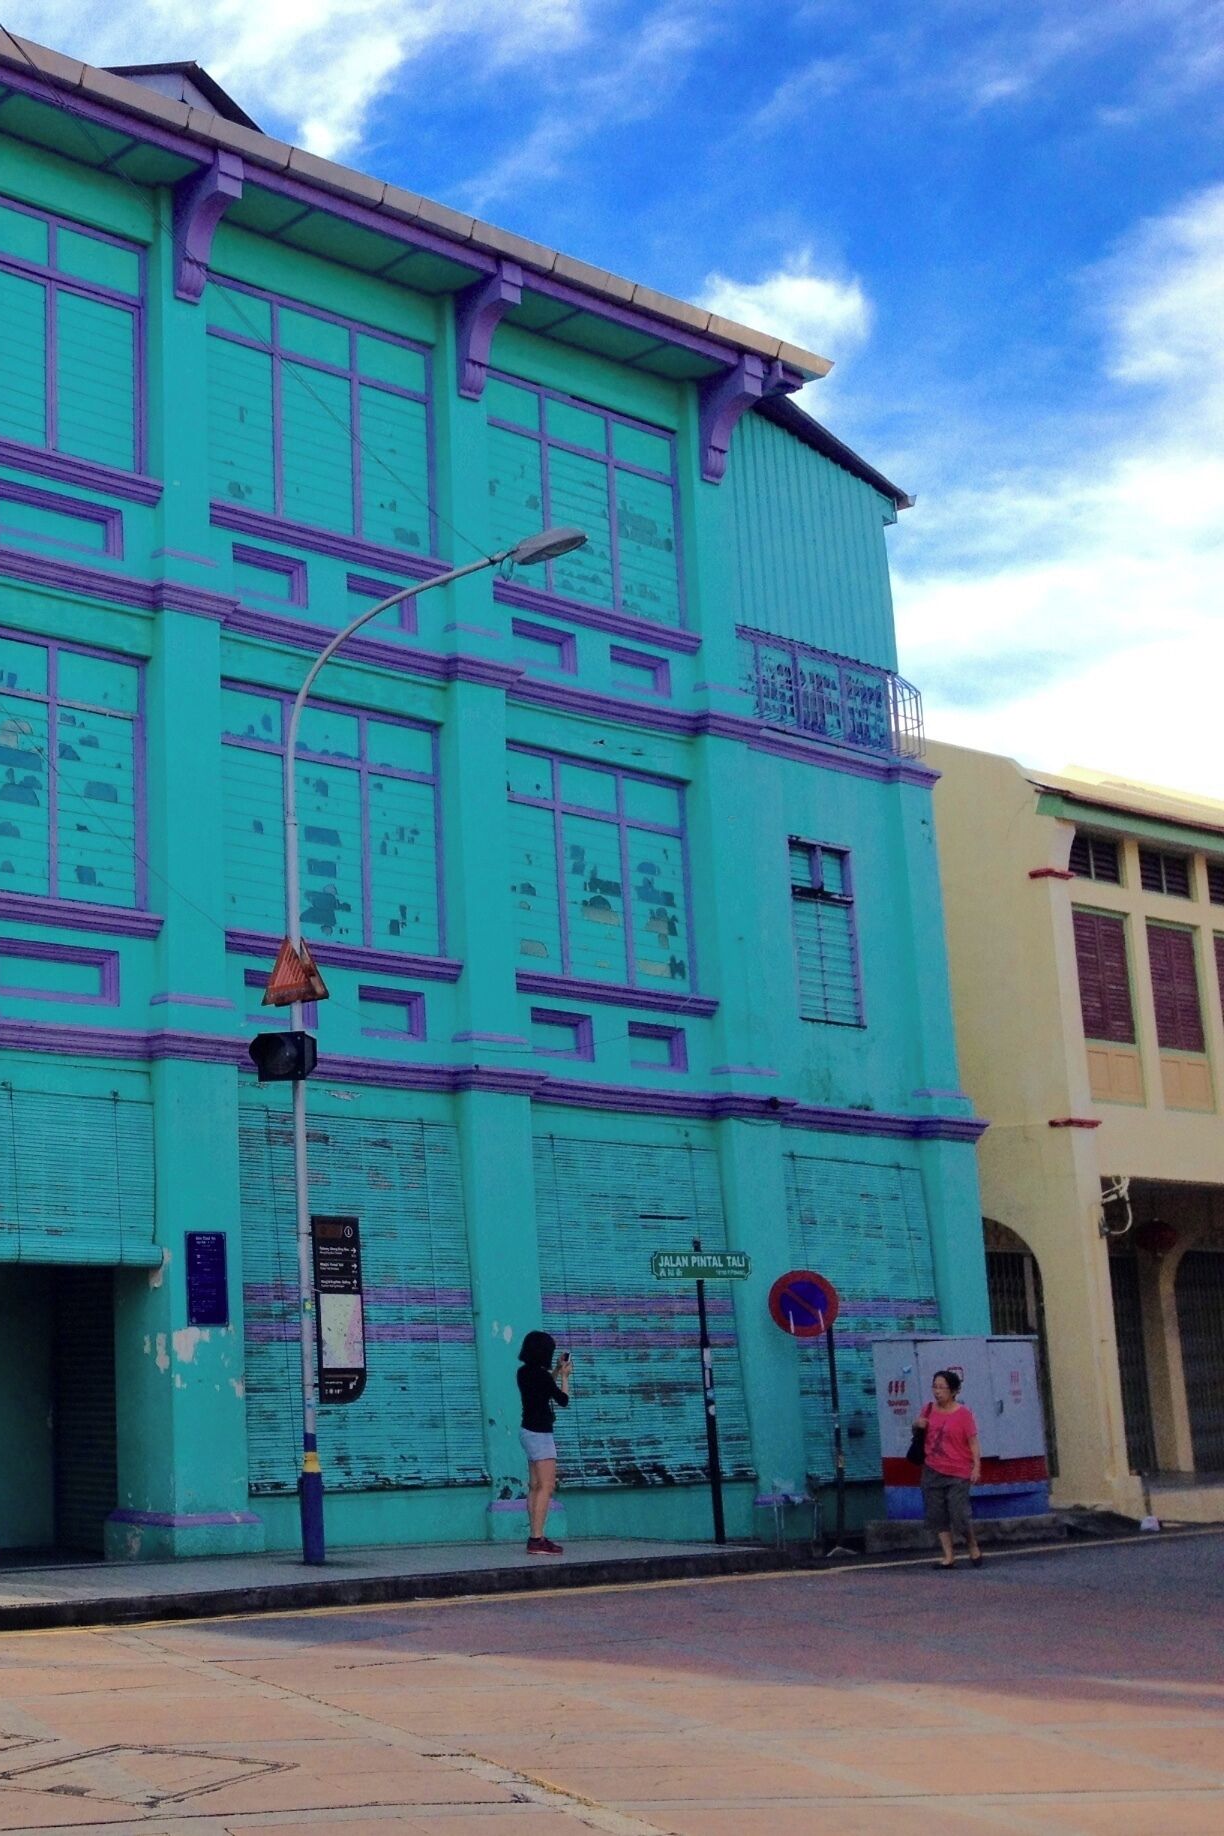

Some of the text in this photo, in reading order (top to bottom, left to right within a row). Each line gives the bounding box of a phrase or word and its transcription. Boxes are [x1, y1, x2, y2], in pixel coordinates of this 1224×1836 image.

[658, 1255, 745, 1268] JALAN PINTAL TALI
